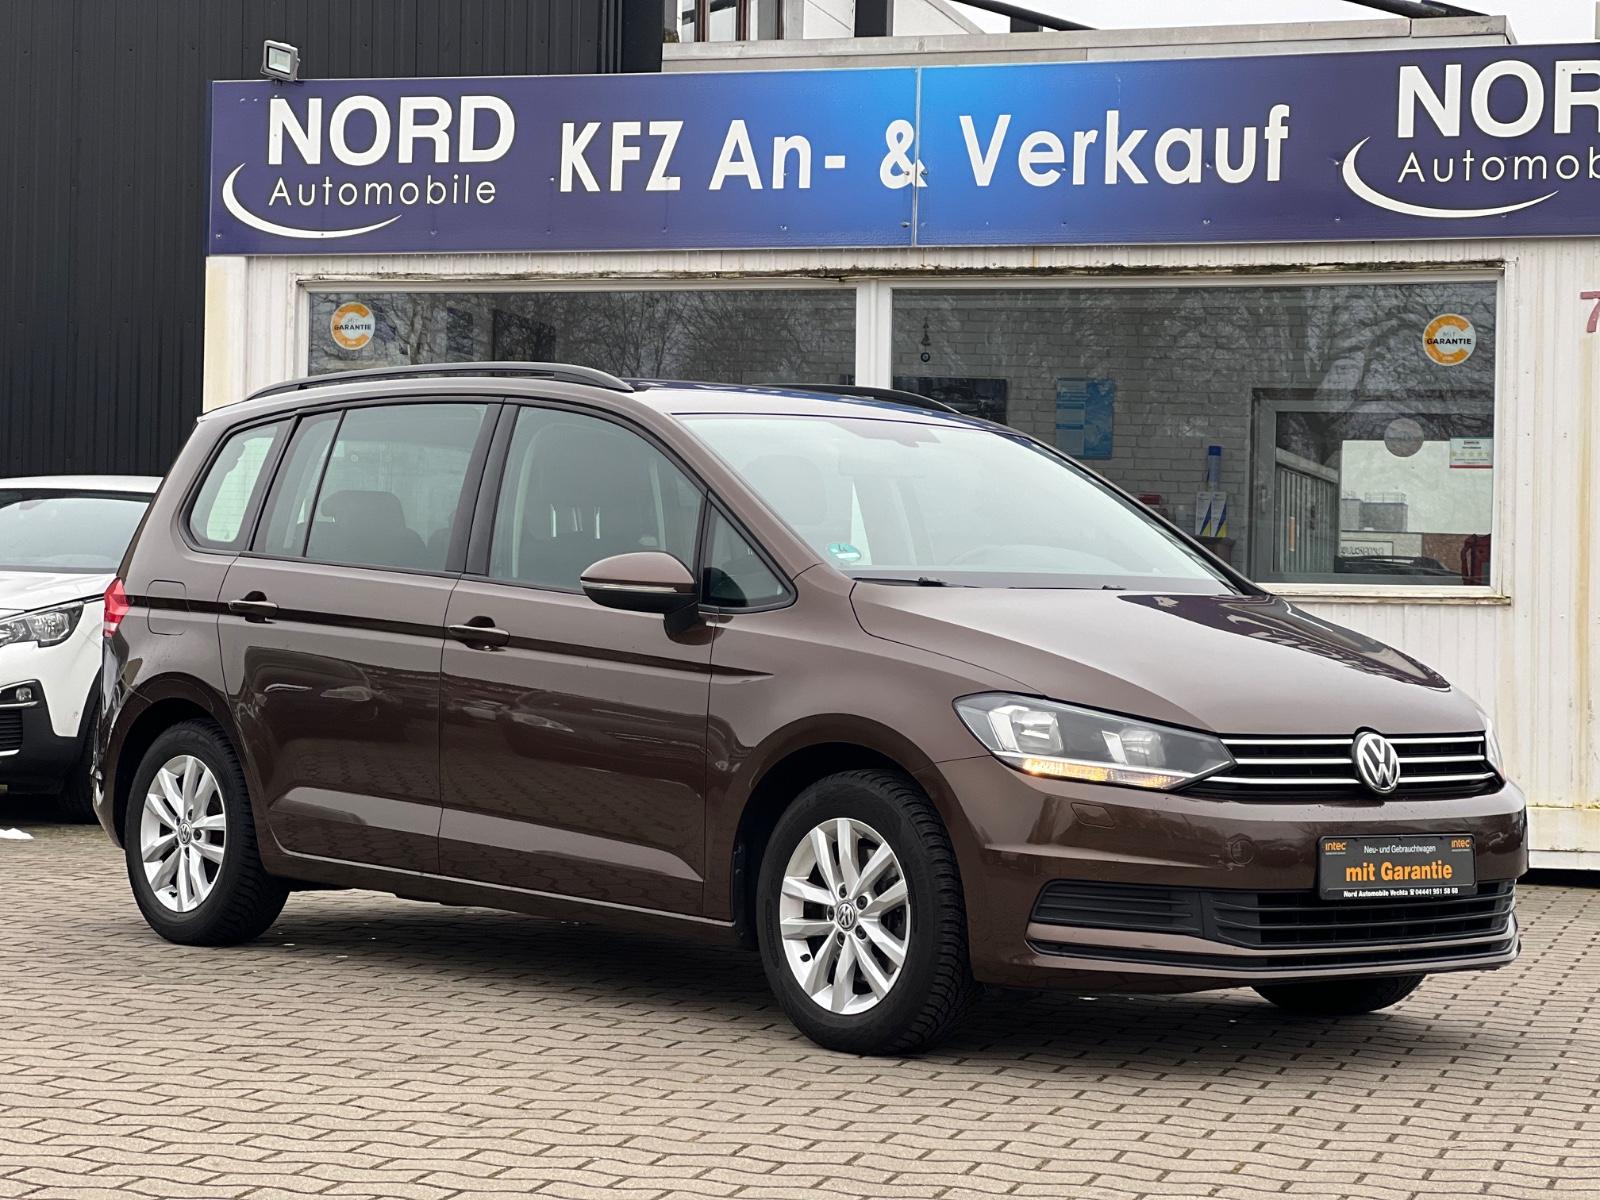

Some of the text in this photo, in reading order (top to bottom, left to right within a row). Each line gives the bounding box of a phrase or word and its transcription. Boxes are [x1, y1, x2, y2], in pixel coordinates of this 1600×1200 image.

[268, 95, 515, 166] NORD
[559, 104, 1290, 193] KFZ An- & Verkauf
[268, 174, 496, 206] Automobile
[1325, 842, 1346, 851] intec
[1364, 844, 1436, 855] Neu- und Gebrauchtwagen
[1451, 839, 1471, 848] intec
[1345, 860, 1453, 881] mit Garantie
[1343, 890, 1358, 898] Nord
[1358, 889, 1389, 897] Automobile
